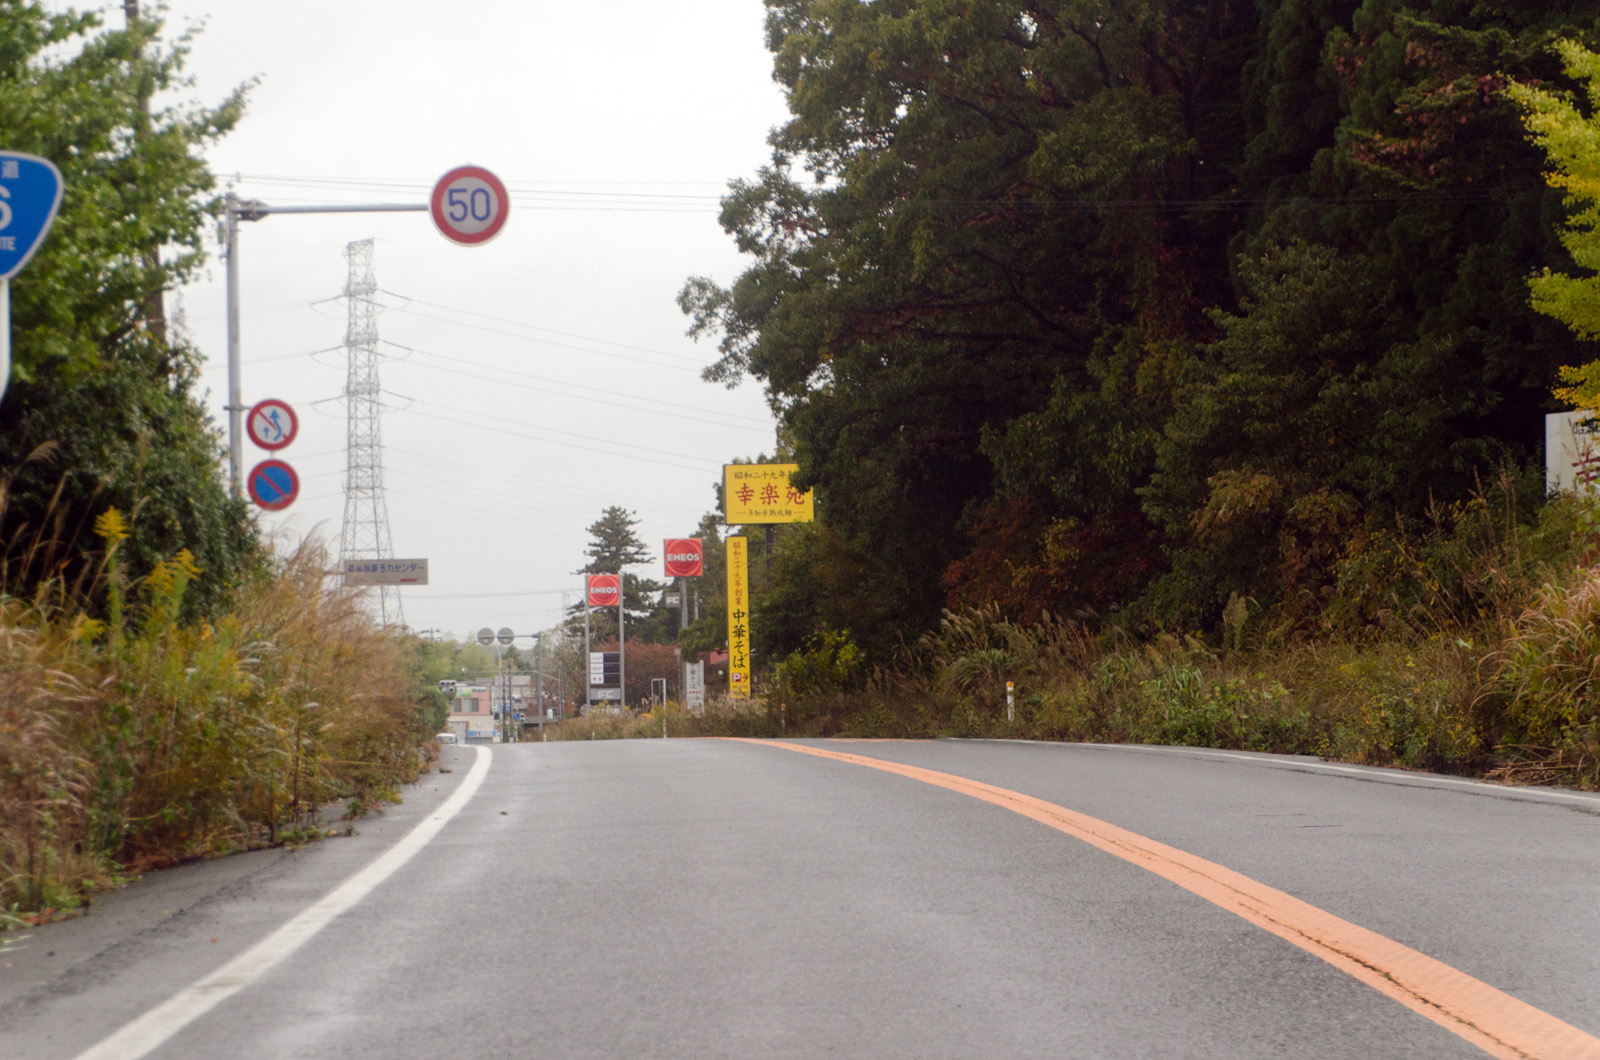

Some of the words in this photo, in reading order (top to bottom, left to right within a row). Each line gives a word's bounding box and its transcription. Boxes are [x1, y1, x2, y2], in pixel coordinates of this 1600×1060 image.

[448, 188, 491, 222] 50
[734, 471, 792, 480] 昭和二十九年
[735, 482, 805, 506] 幸楽苑
[667, 553, 700, 562] ENEOS
[590, 586, 617, 594] ENEOS
[732, 608, 748, 669] 中華そば
[733, 673, 742, 682] P
